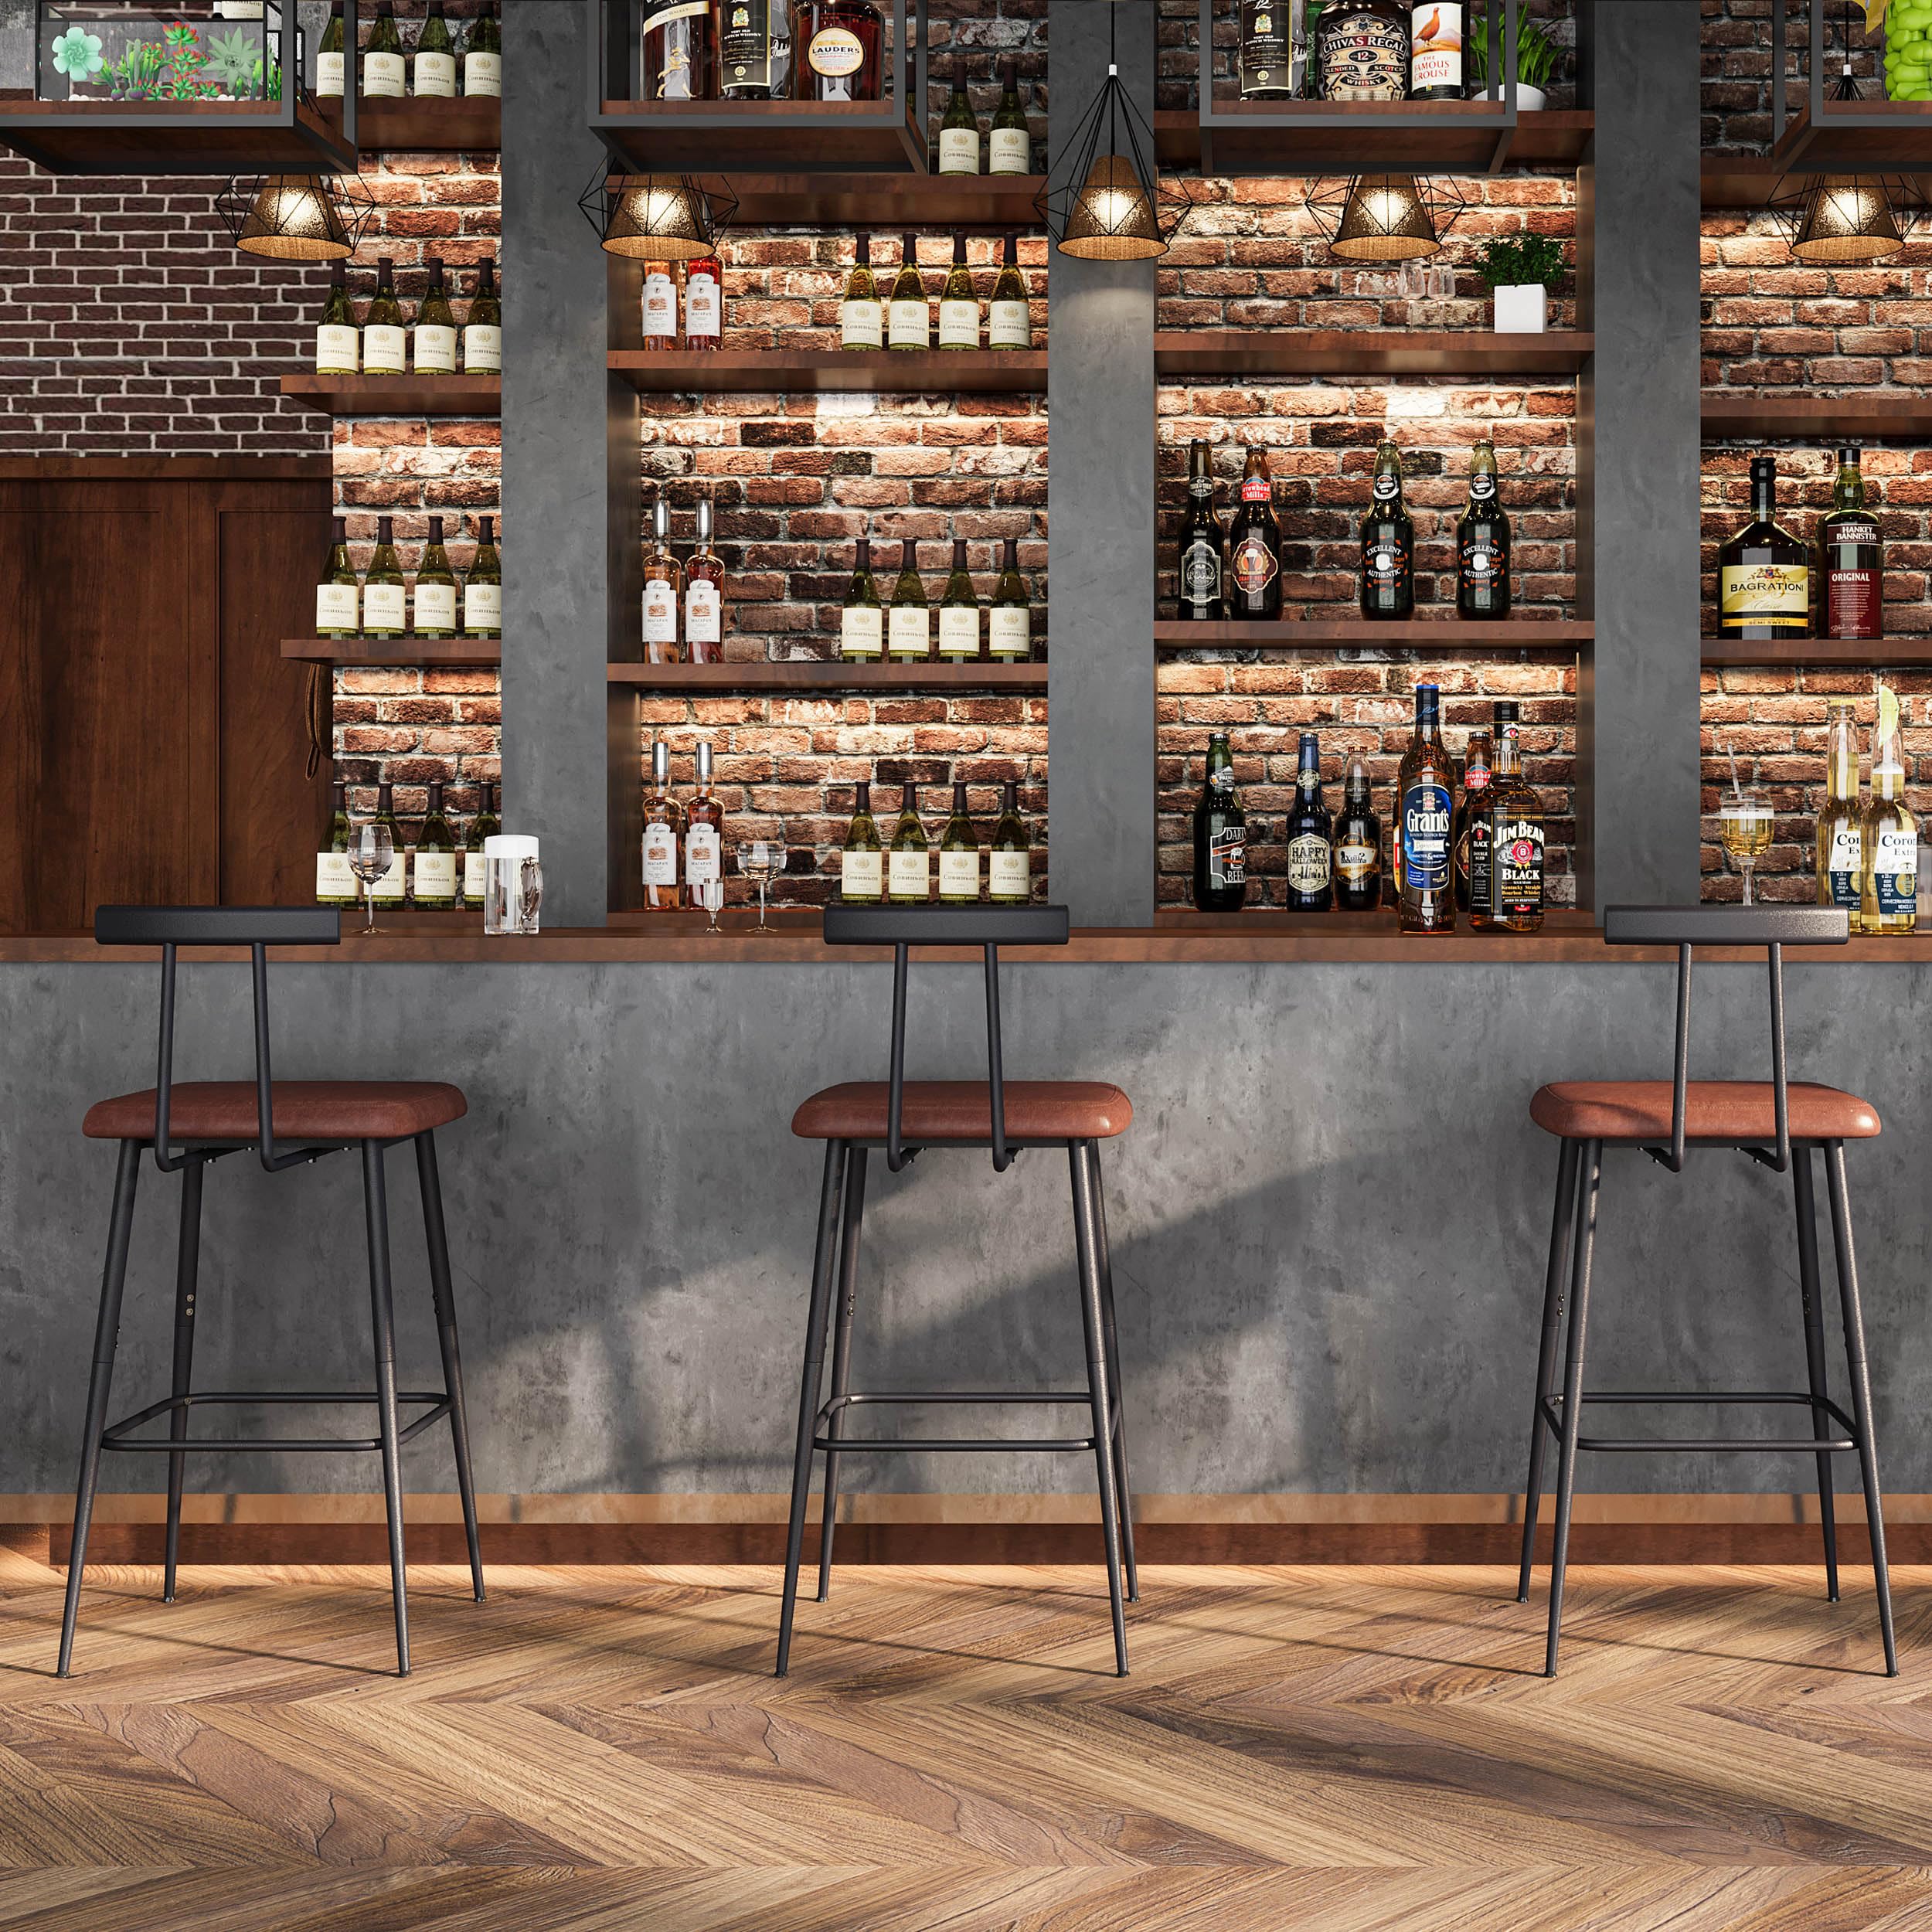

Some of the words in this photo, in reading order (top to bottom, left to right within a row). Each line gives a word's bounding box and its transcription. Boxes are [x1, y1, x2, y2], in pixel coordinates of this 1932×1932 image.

[1323, 36, 1365, 53] CHIVAS
[1367, 37, 1405, 53] REGAL
[1357, 51, 1368, 61] 12
[1325, 65, 1355, 73] BLENDED
[1414, 60, 1450, 72] FAMOUS
[1414, 70, 1448, 82] GROUSE
[1346, 78, 1382, 86] WHISKY
[1367, 545, 1402, 556] EXCELLENT
[1463, 545, 1498, 556] EXCELLENT
[1367, 568, 1401, 578] AUTHENTIC
[1464, 568, 1497, 578] AUTHENTIC
[1832, 573, 1870, 582] ORIGINAL
[1731, 583, 1803, 592] BAGRATIONI
[1407, 808, 1449, 832] Grant's
[1493, 825, 1517, 849] JIM
[1518, 821, 1544, 847] BEAM
[1292, 847, 1326, 857] HAPPY
[1502, 868, 1540, 880] BLACK
